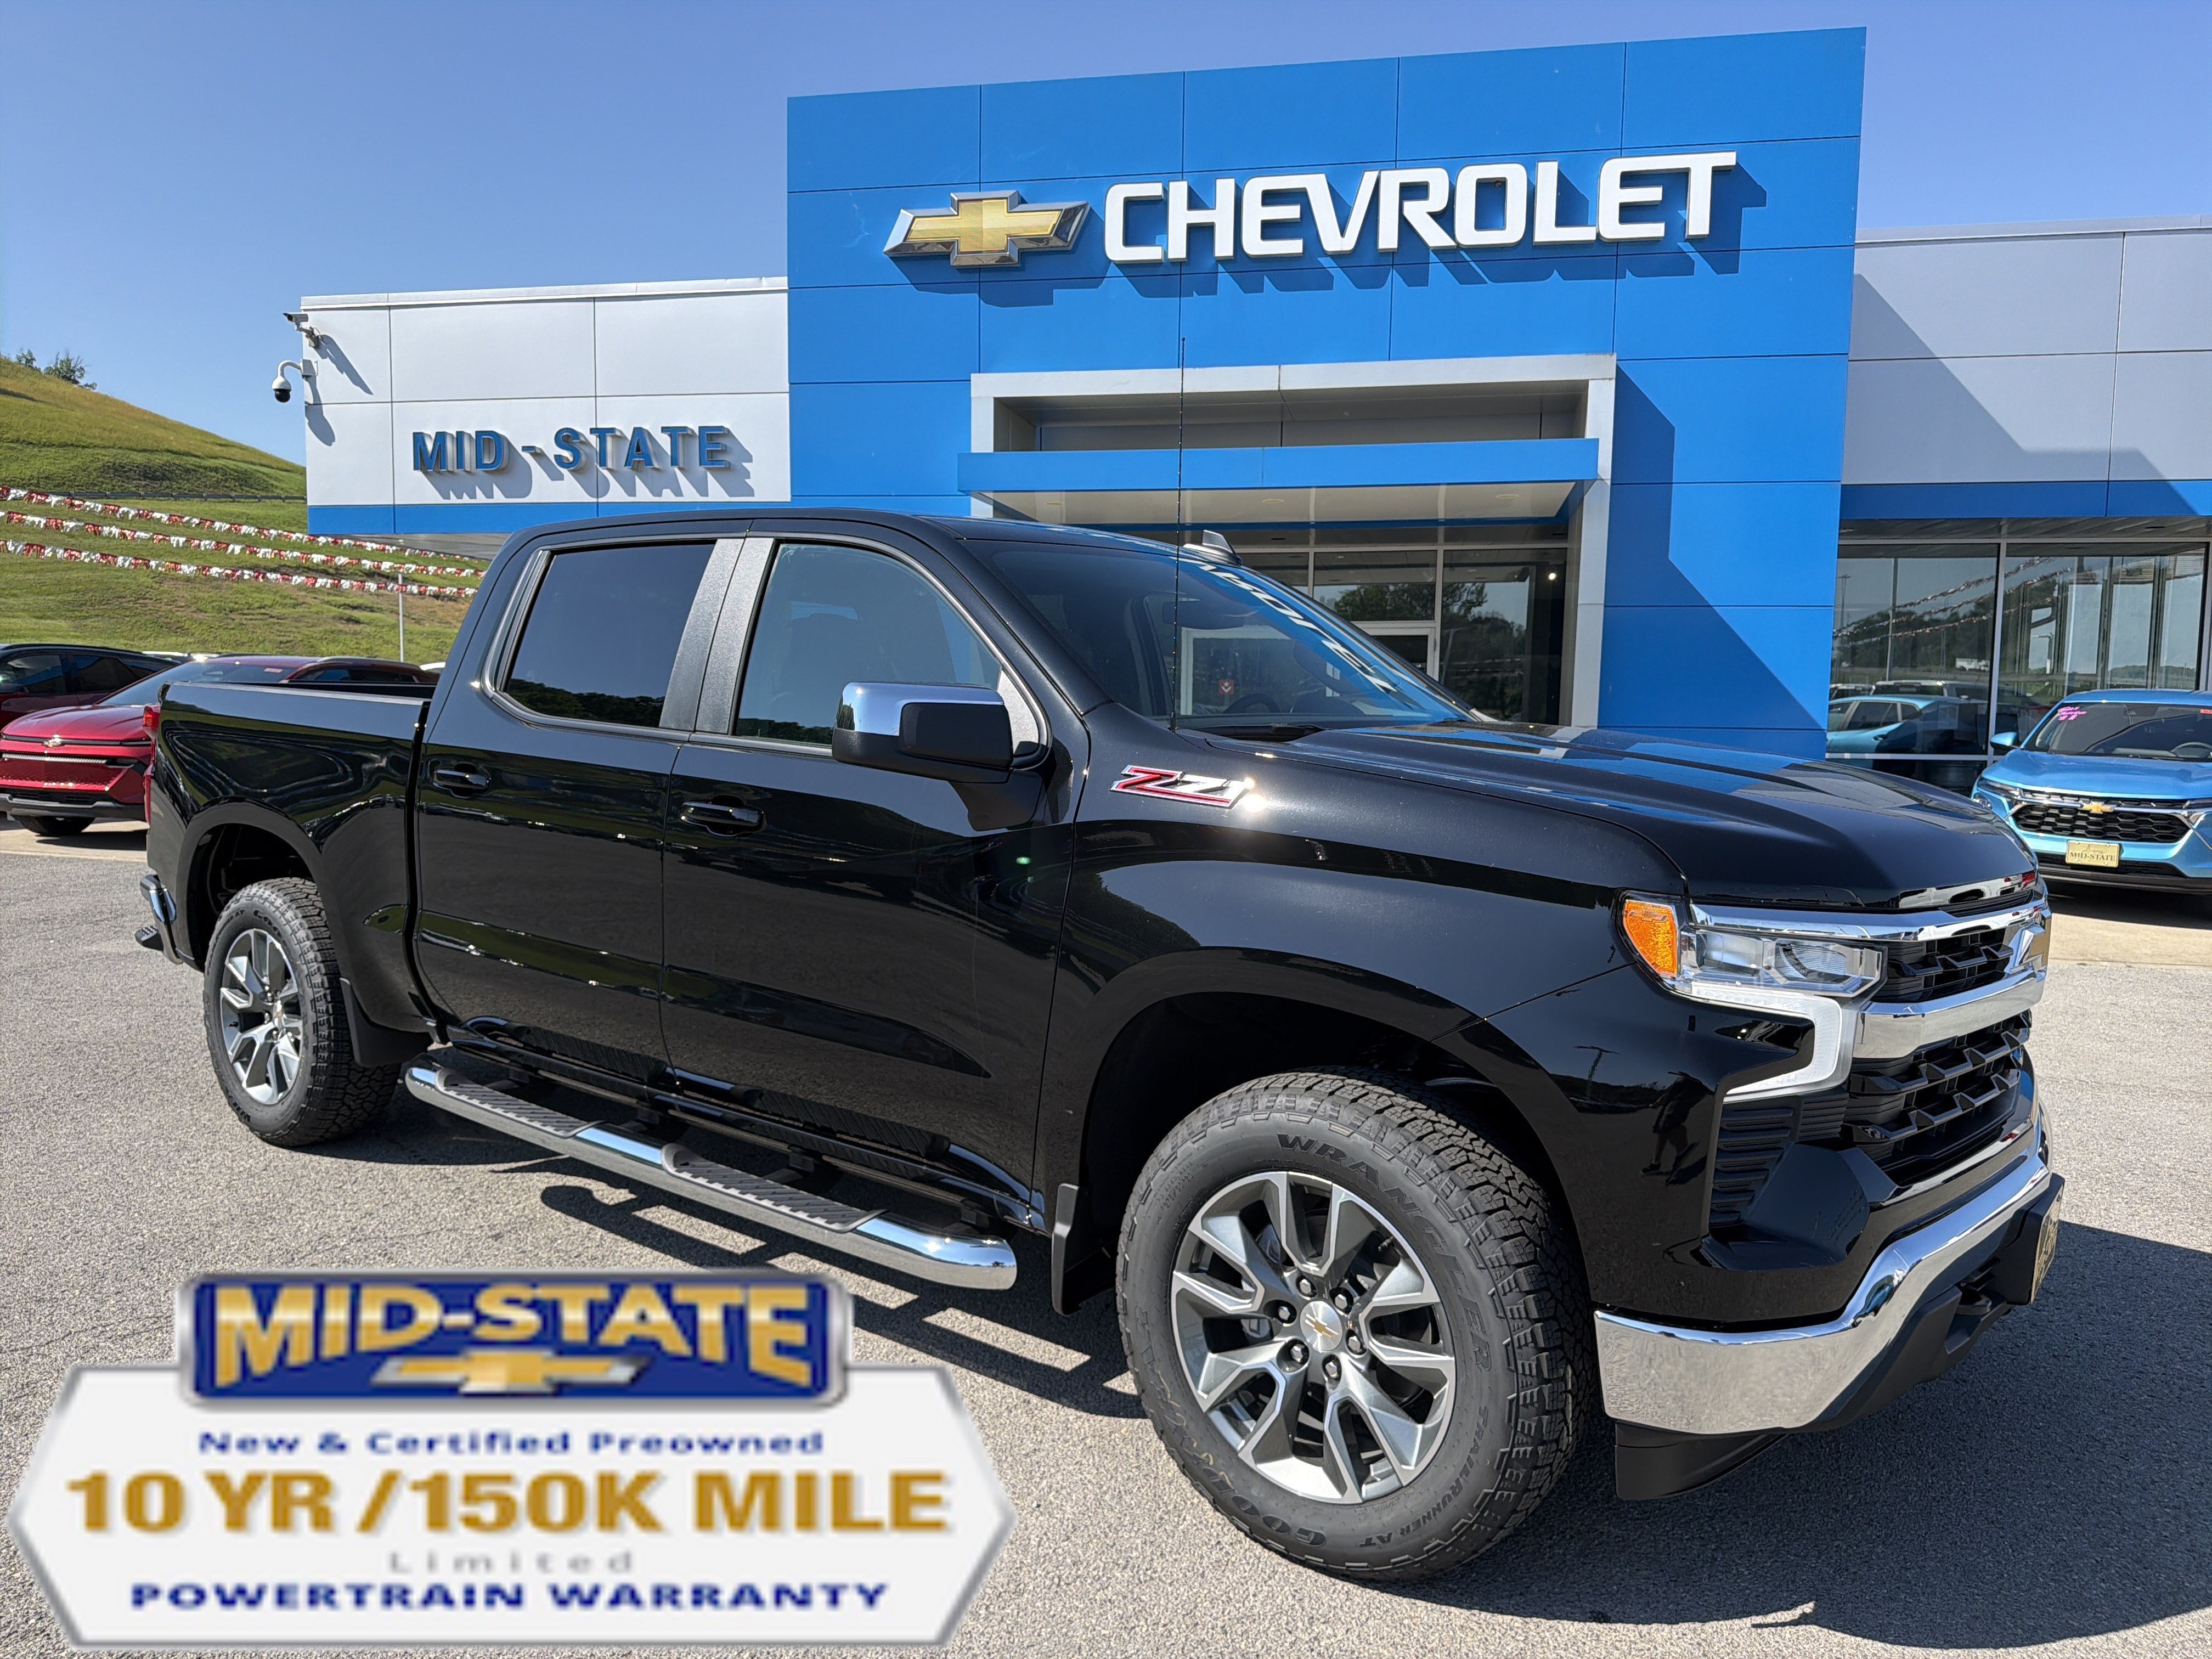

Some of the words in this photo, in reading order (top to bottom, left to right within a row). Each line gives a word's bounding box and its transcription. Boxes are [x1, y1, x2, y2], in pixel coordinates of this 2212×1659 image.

[1104, 150, 1737, 264] CHEVROLET
[412, 425, 730, 472] MID-STATE
[1109, 765, 1255, 809] Z71
[2069, 851, 2115, 861] MID-STATE
[1277, 1133, 1491, 1371] WRANGLER
[1359, 1532, 1393, 1548] AT
